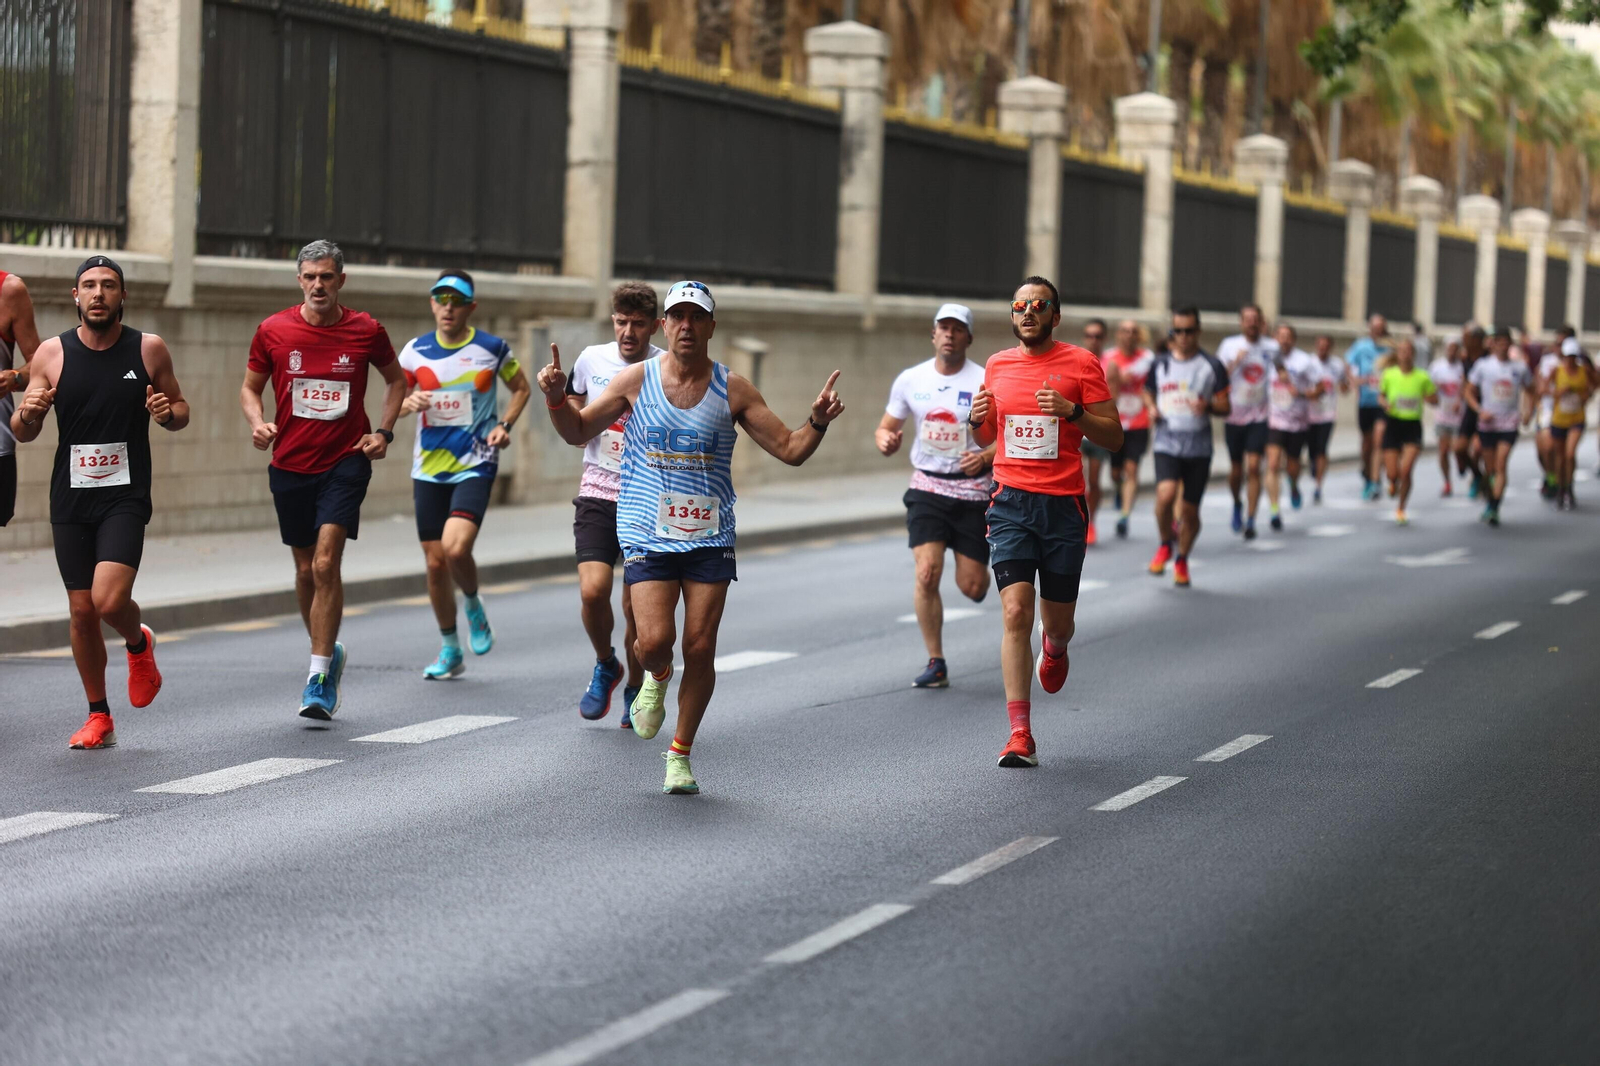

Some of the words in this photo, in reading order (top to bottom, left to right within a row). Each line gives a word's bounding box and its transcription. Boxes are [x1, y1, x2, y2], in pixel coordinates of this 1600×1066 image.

[302, 389, 341, 401] 1258
[928, 431, 959, 441] 1272
[1015, 427, 1045, 438] 873
[643, 425, 719, 453] RCJ
[80, 454, 120, 467] 1322
[668, 506, 711, 520] 1342
